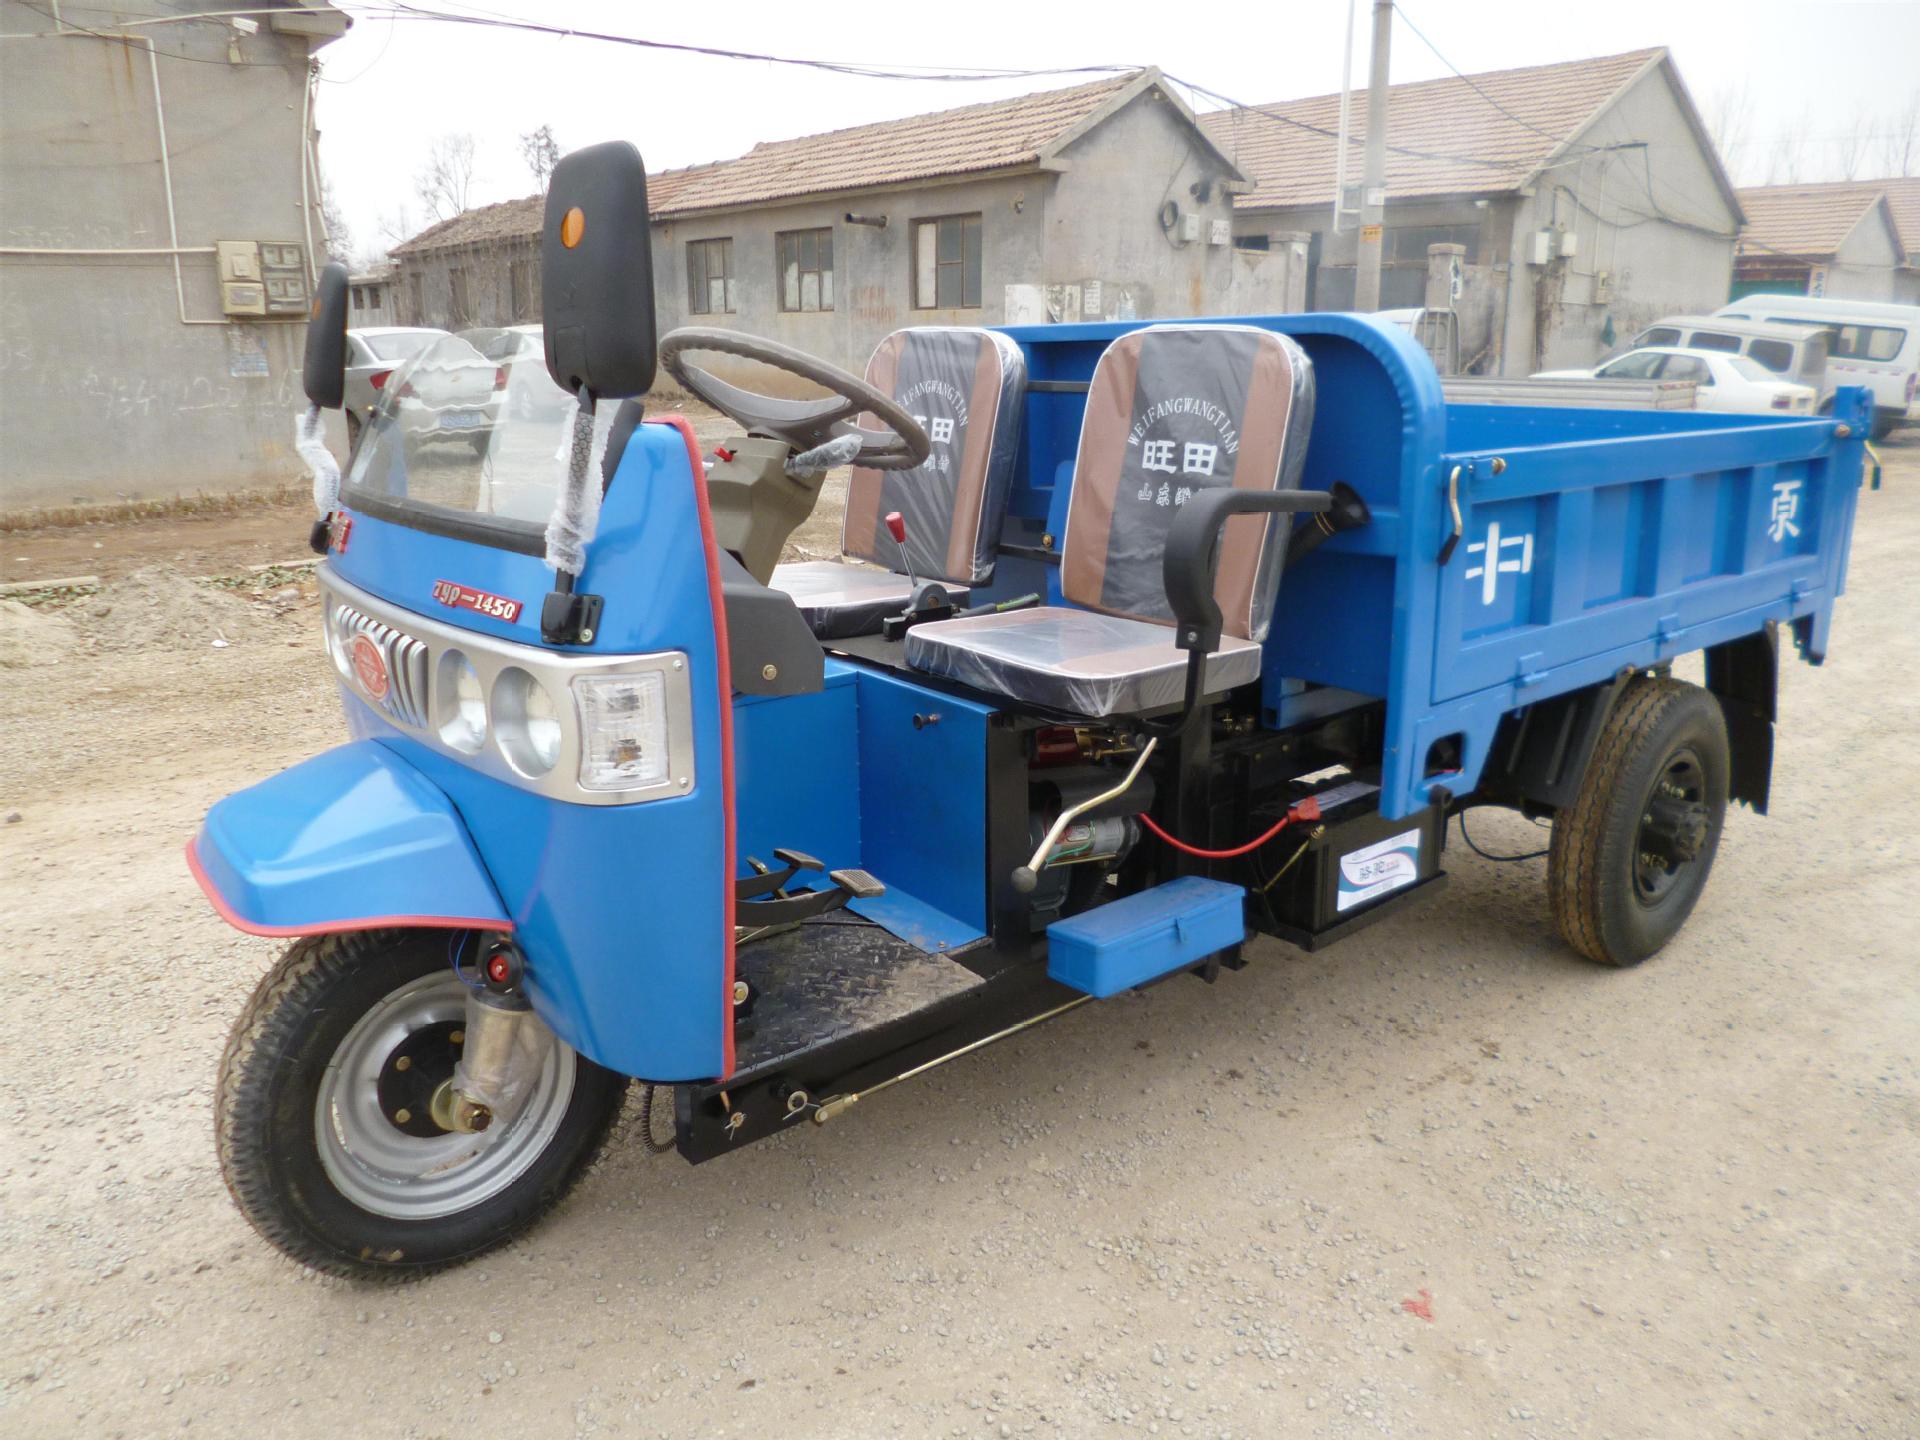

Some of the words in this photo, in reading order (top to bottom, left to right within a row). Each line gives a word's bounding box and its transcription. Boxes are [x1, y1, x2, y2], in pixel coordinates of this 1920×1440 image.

[913, 415, 954, 444] 田
[1128, 398, 1239, 454] WEIFANGWANGTIAN
[1142, 440, 1217, 476] 旺田
[1465, 521, 1533, 606] 中
[1768, 480, 1802, 543] 原
